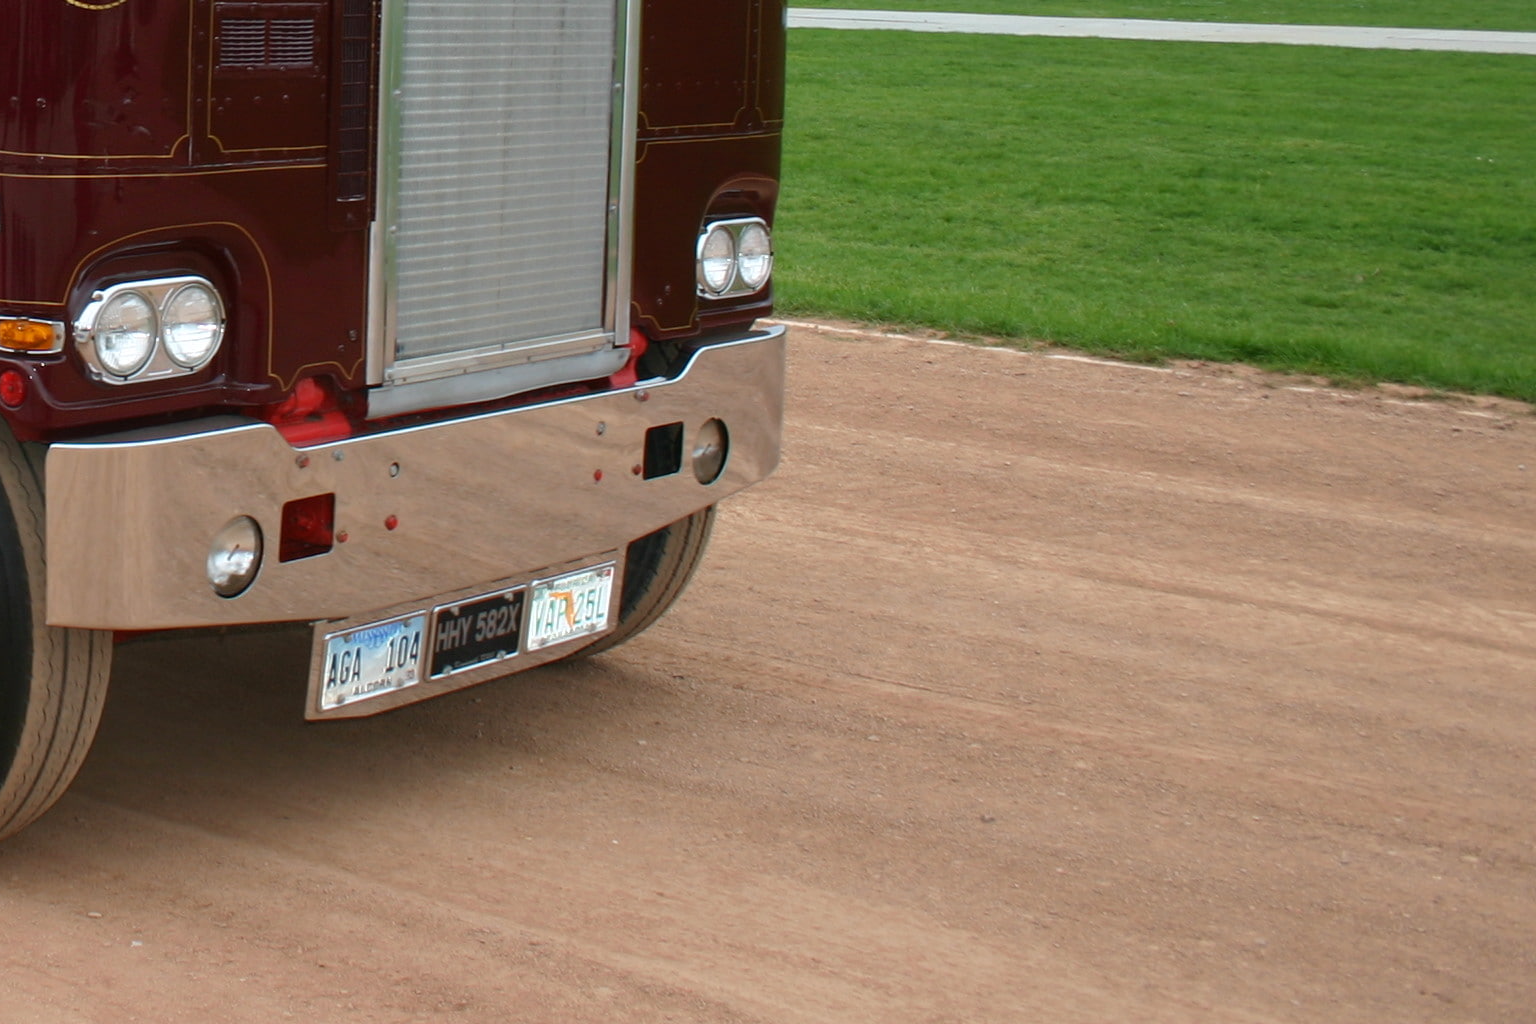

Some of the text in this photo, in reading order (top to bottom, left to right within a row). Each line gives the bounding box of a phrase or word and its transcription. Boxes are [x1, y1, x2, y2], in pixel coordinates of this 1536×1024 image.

[436, 615, 473, 653] HHY
[475, 603, 520, 642] 582X
[327, 631, 421, 689] AGA 104
